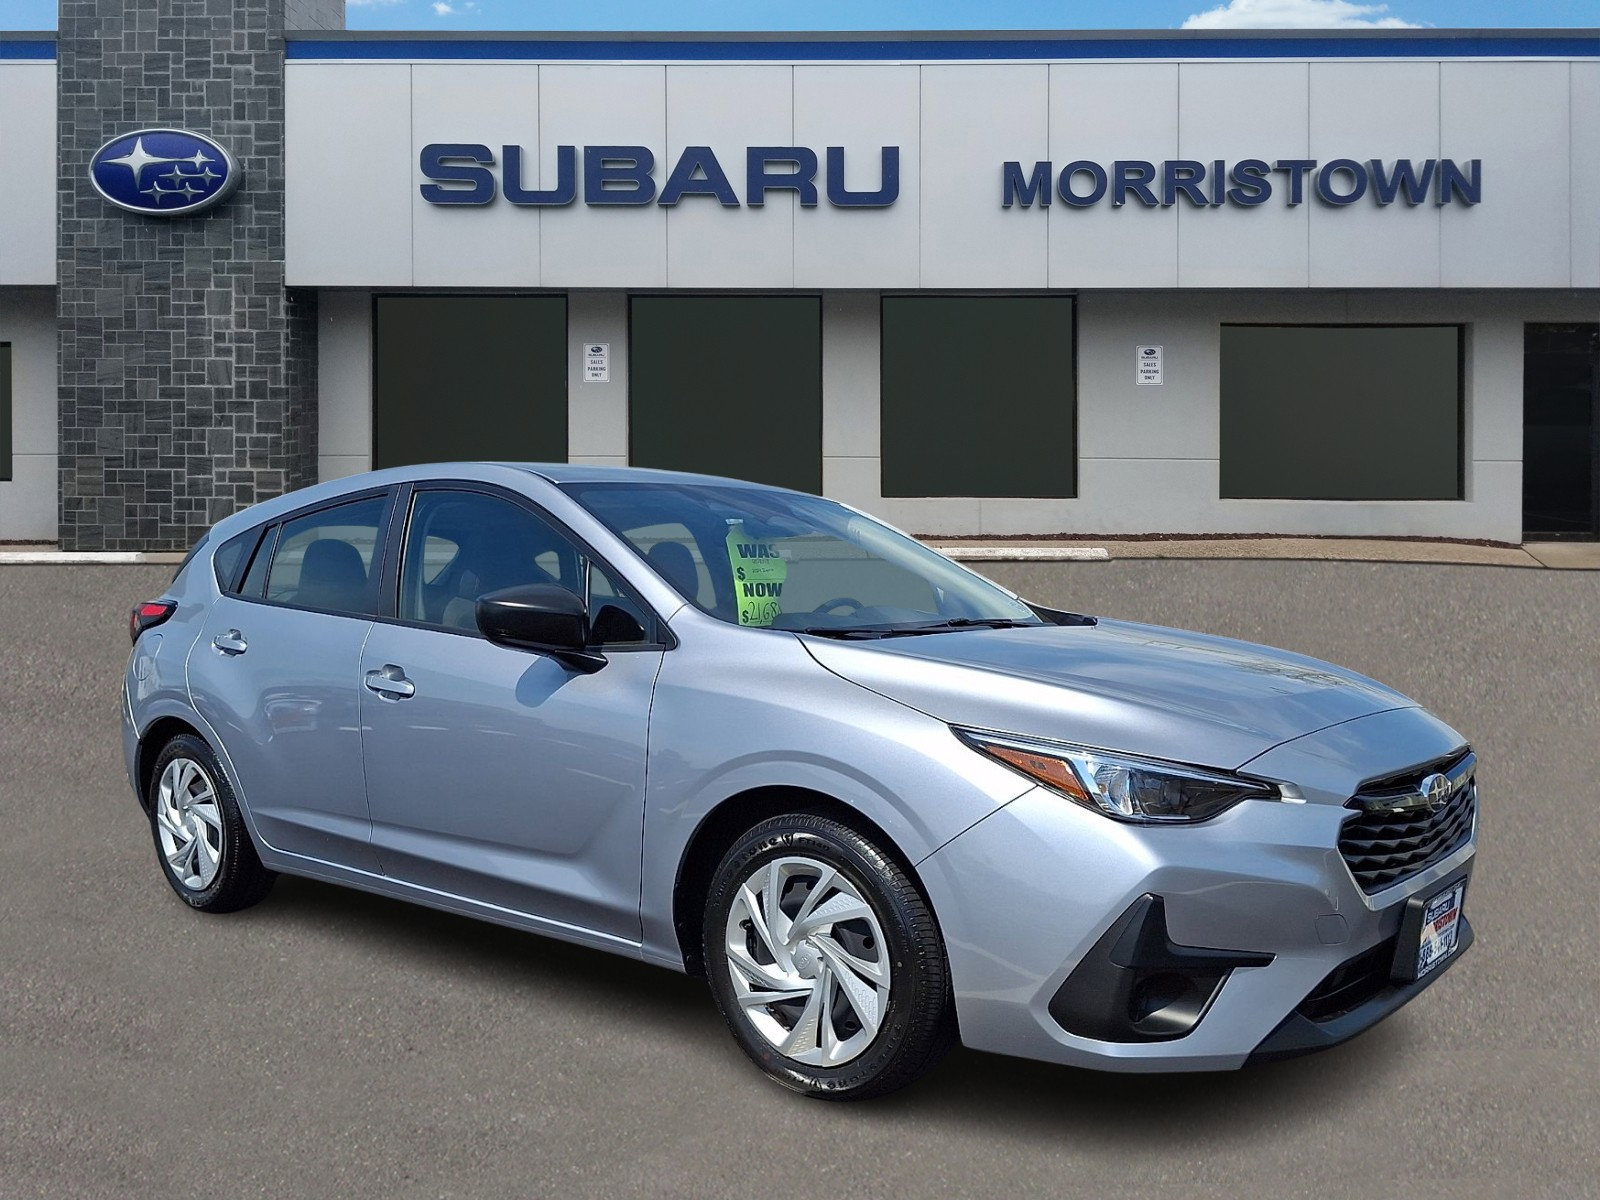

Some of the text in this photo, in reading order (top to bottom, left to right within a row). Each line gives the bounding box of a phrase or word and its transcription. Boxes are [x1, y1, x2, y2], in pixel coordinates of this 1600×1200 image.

[420, 144, 901, 207] SUBARU
[1002, 159, 1482, 207] MORRISTOWN
[736, 543, 780, 559] WAS
[736, 566, 746, 582] $
[742, 582, 783, 598] NOW
